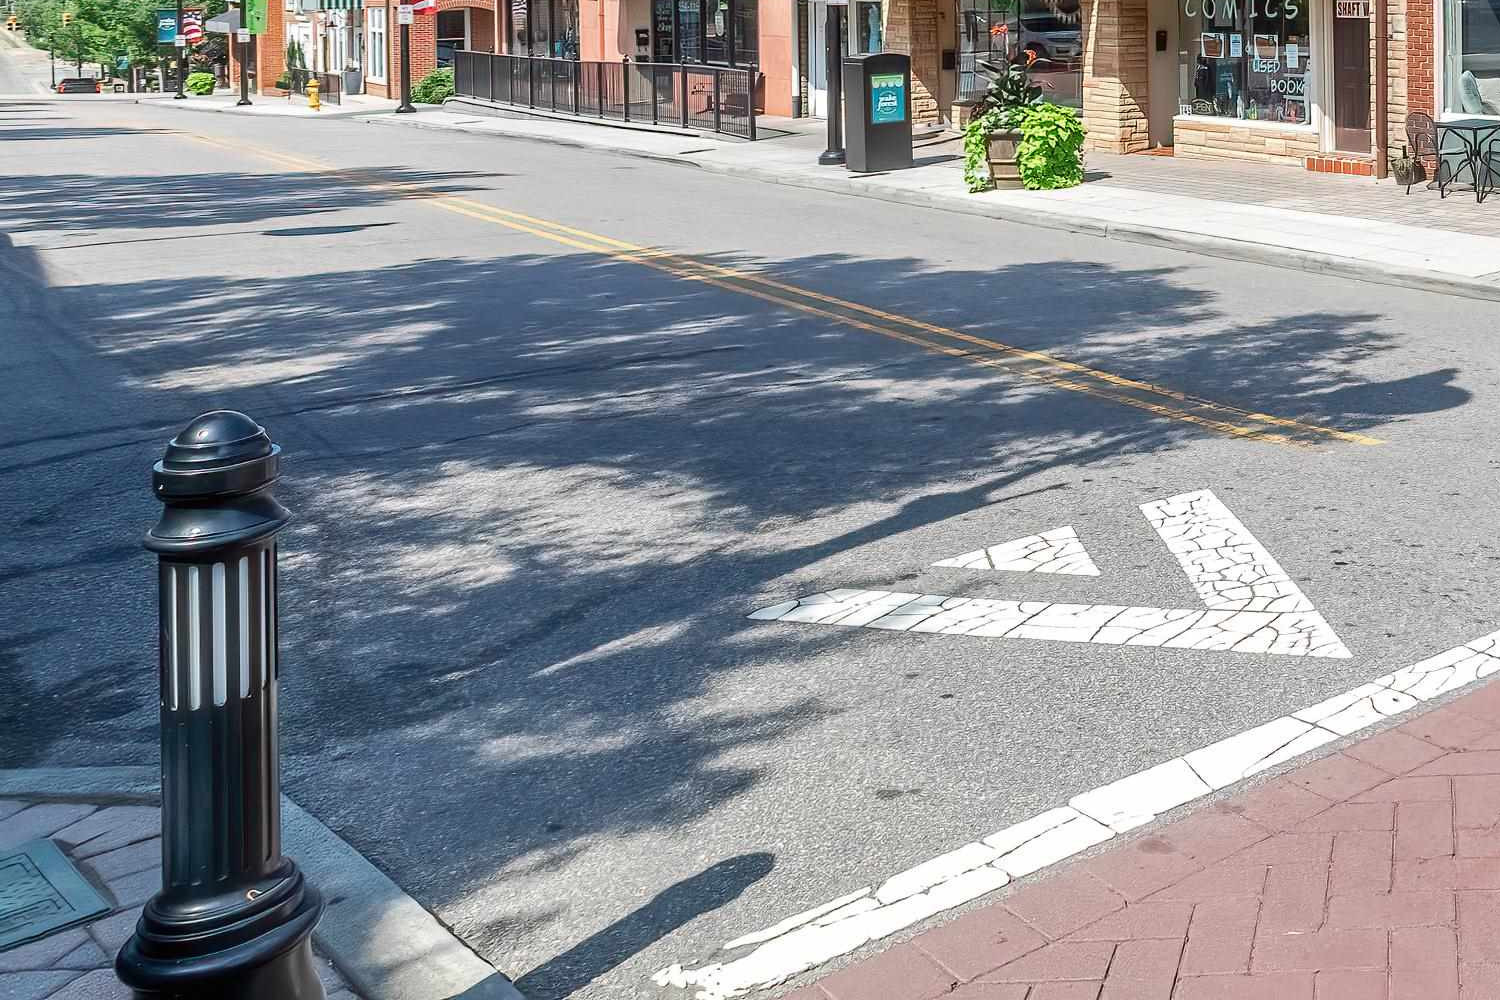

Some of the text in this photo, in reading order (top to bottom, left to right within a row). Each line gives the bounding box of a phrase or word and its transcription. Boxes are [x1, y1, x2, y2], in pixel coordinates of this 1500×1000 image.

[1337, 1, 1361, 17] SHAFT
[1252, 60, 1281, 73] USED
[1270, 79, 1305, 93] BOOK
